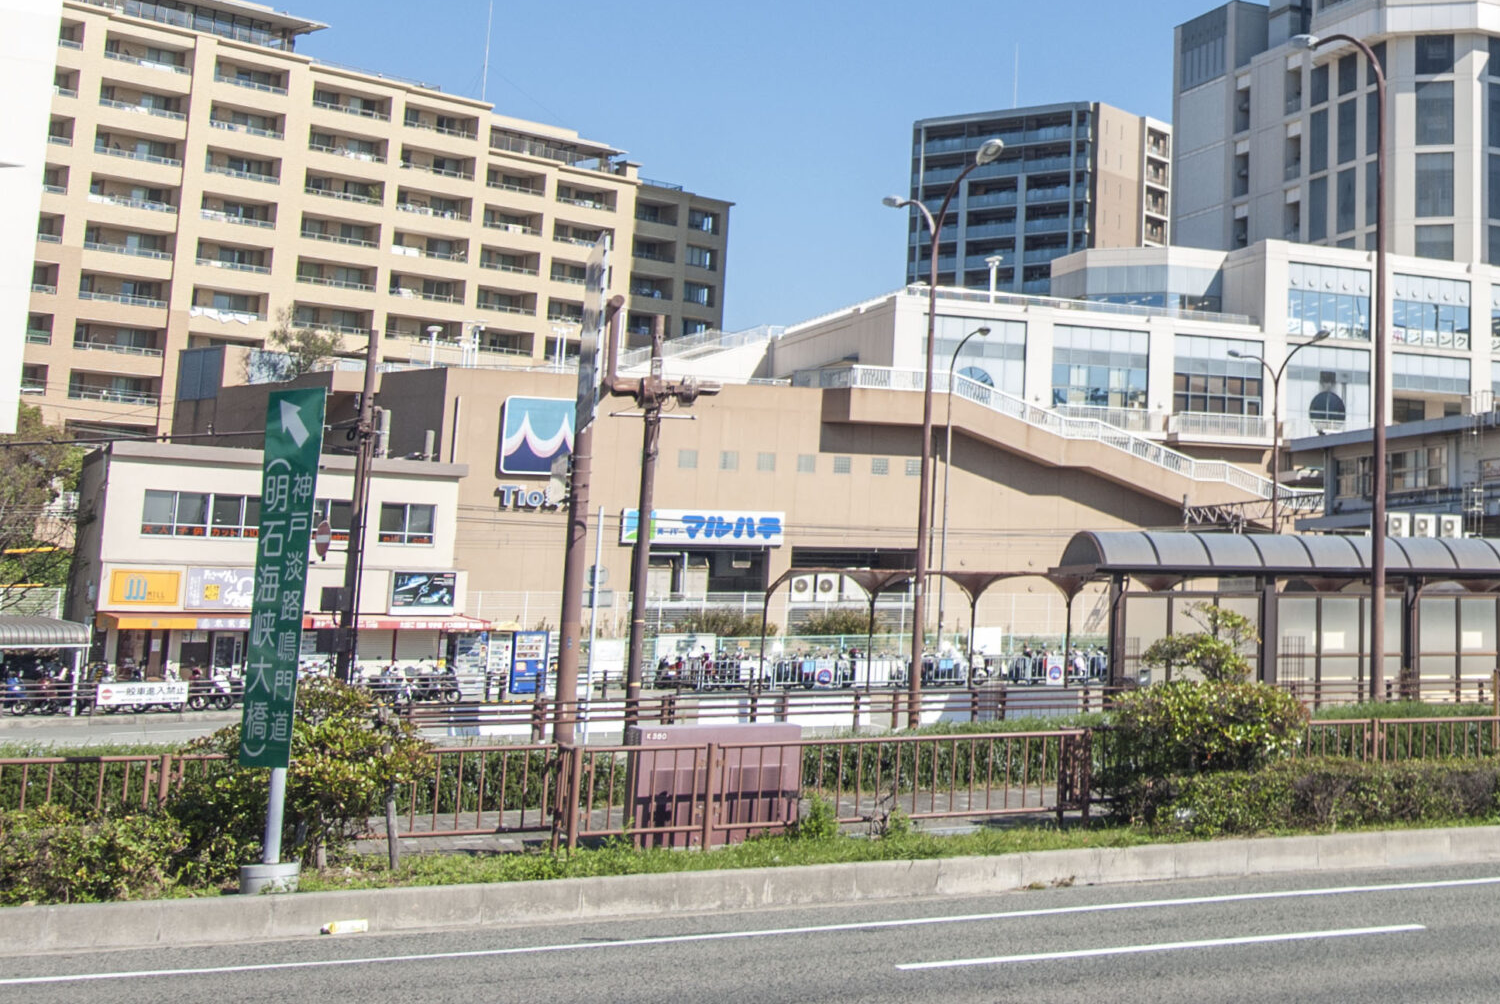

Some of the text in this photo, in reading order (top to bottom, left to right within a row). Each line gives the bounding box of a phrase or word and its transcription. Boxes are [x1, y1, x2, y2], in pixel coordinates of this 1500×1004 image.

[681, 515, 782, 540] マルハチ
[268, 472, 313, 742] 神戸淡路鳴門道
